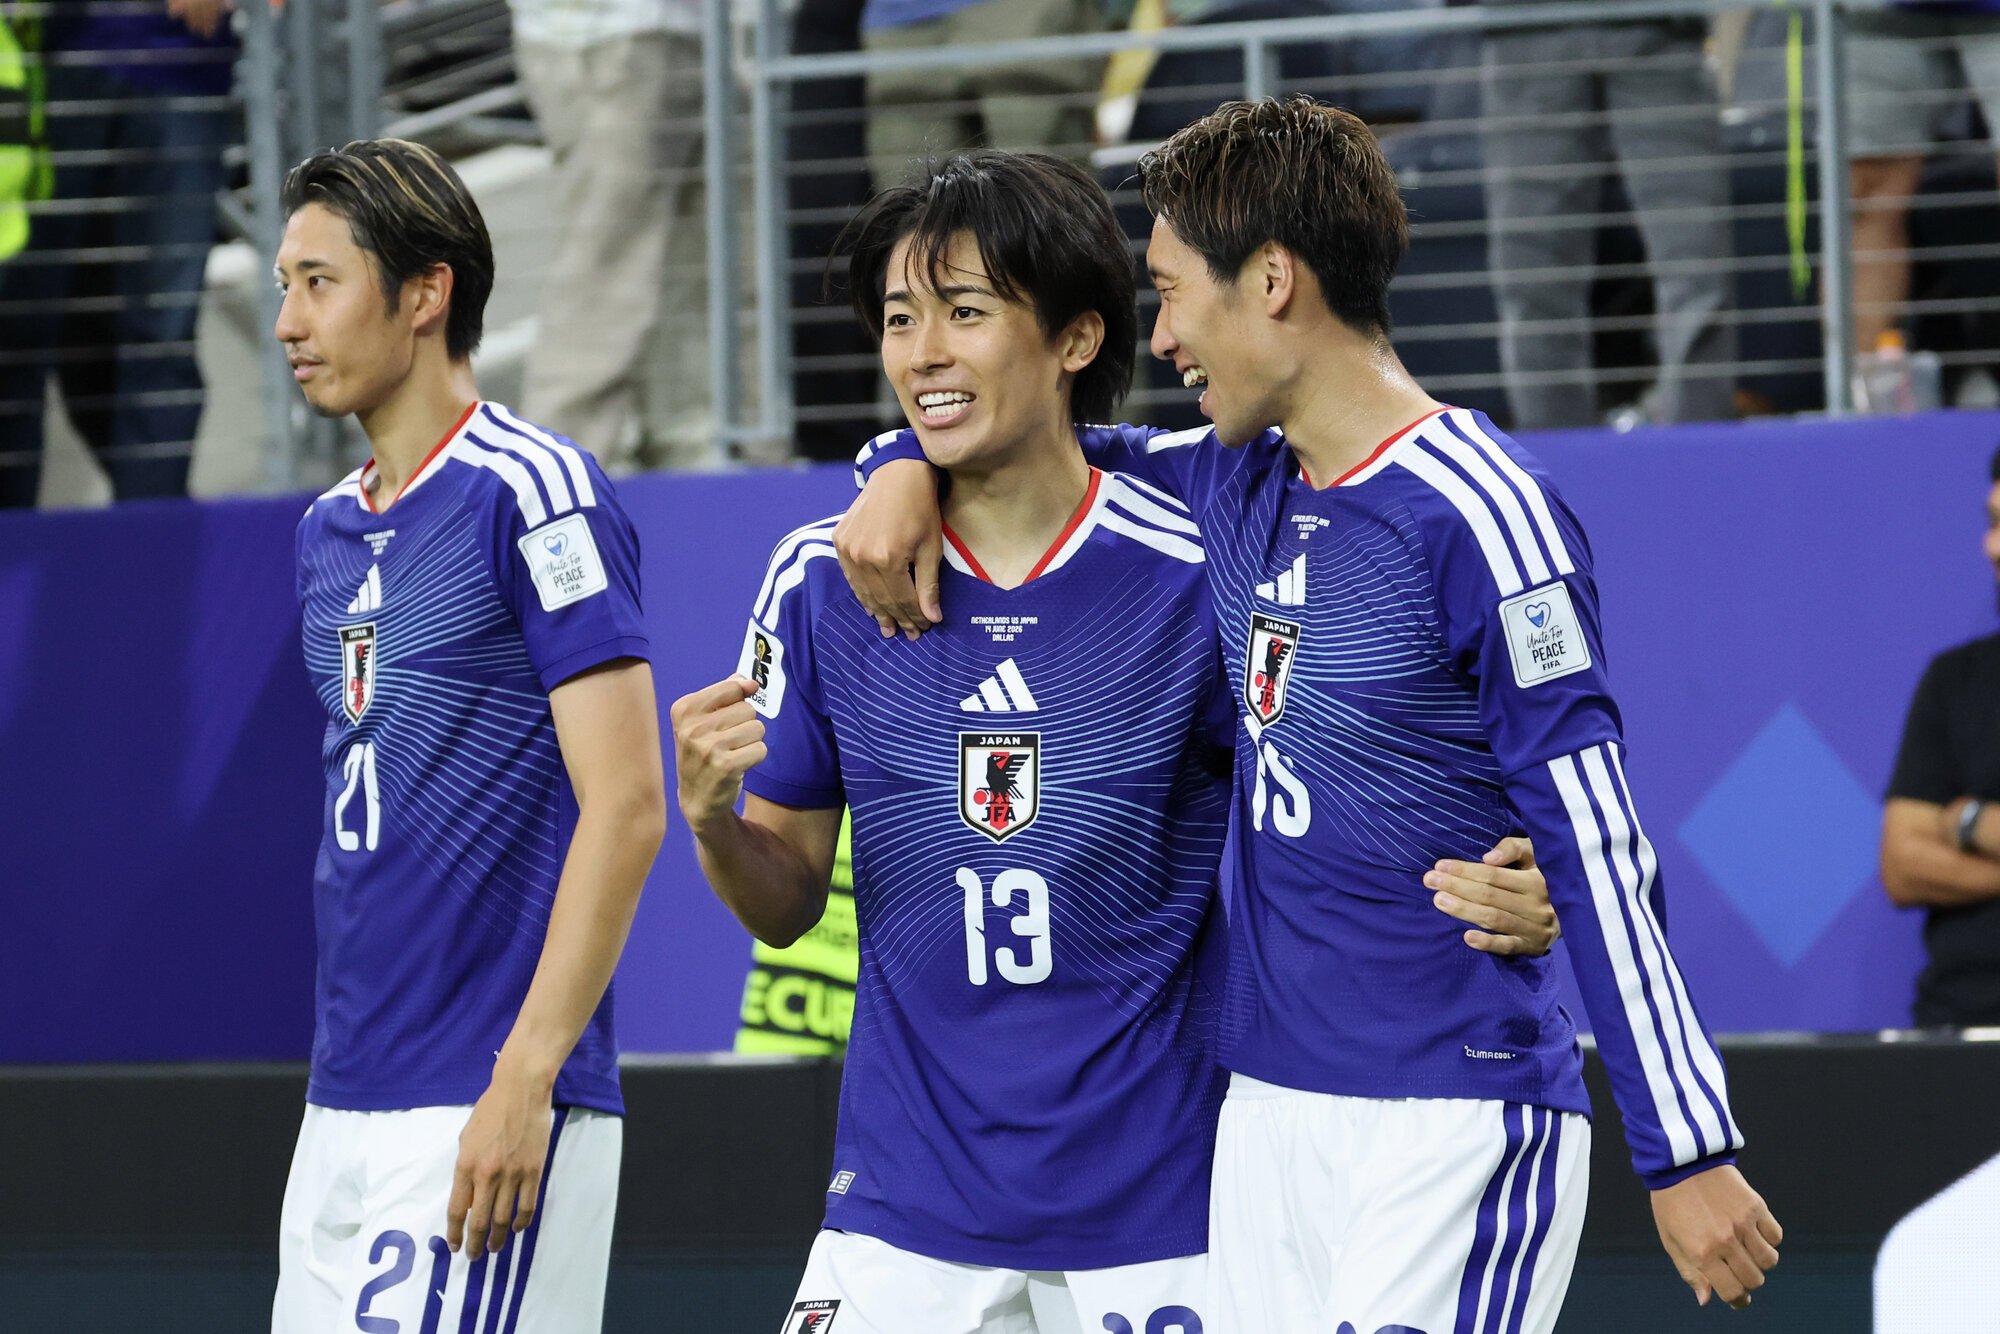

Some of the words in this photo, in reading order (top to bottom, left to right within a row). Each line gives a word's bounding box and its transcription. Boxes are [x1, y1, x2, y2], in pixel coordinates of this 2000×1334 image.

[553, 566, 585, 588] PEACE
[564, 584, 581, 594] FIFA
[1020, 616, 1038, 624] JAPAN
[1264, 620, 1291, 635] JAPAN
[348, 628, 368, 639] JAPAN
[992, 625, 1006, 633] JUNE
[1007, 625, 1023, 633] 2026
[992, 634, 1014, 642] DALLAS
[1526, 631, 1550, 649] Unite
[1549, 625, 1563, 639] For
[1532, 641, 1566, 664] PEACE
[1542, 660, 1561, 671] FIFA
[979, 736, 1020, 745] JAPAN
[1245, 715, 1311, 838] 15
[335, 742, 380, 851] 21
[981, 806, 1017, 822] JFA
[956, 867, 1053, 986] 13
[355, 1229, 452, 1334] 21
[803, 1301, 830, 1310] JAPAN
